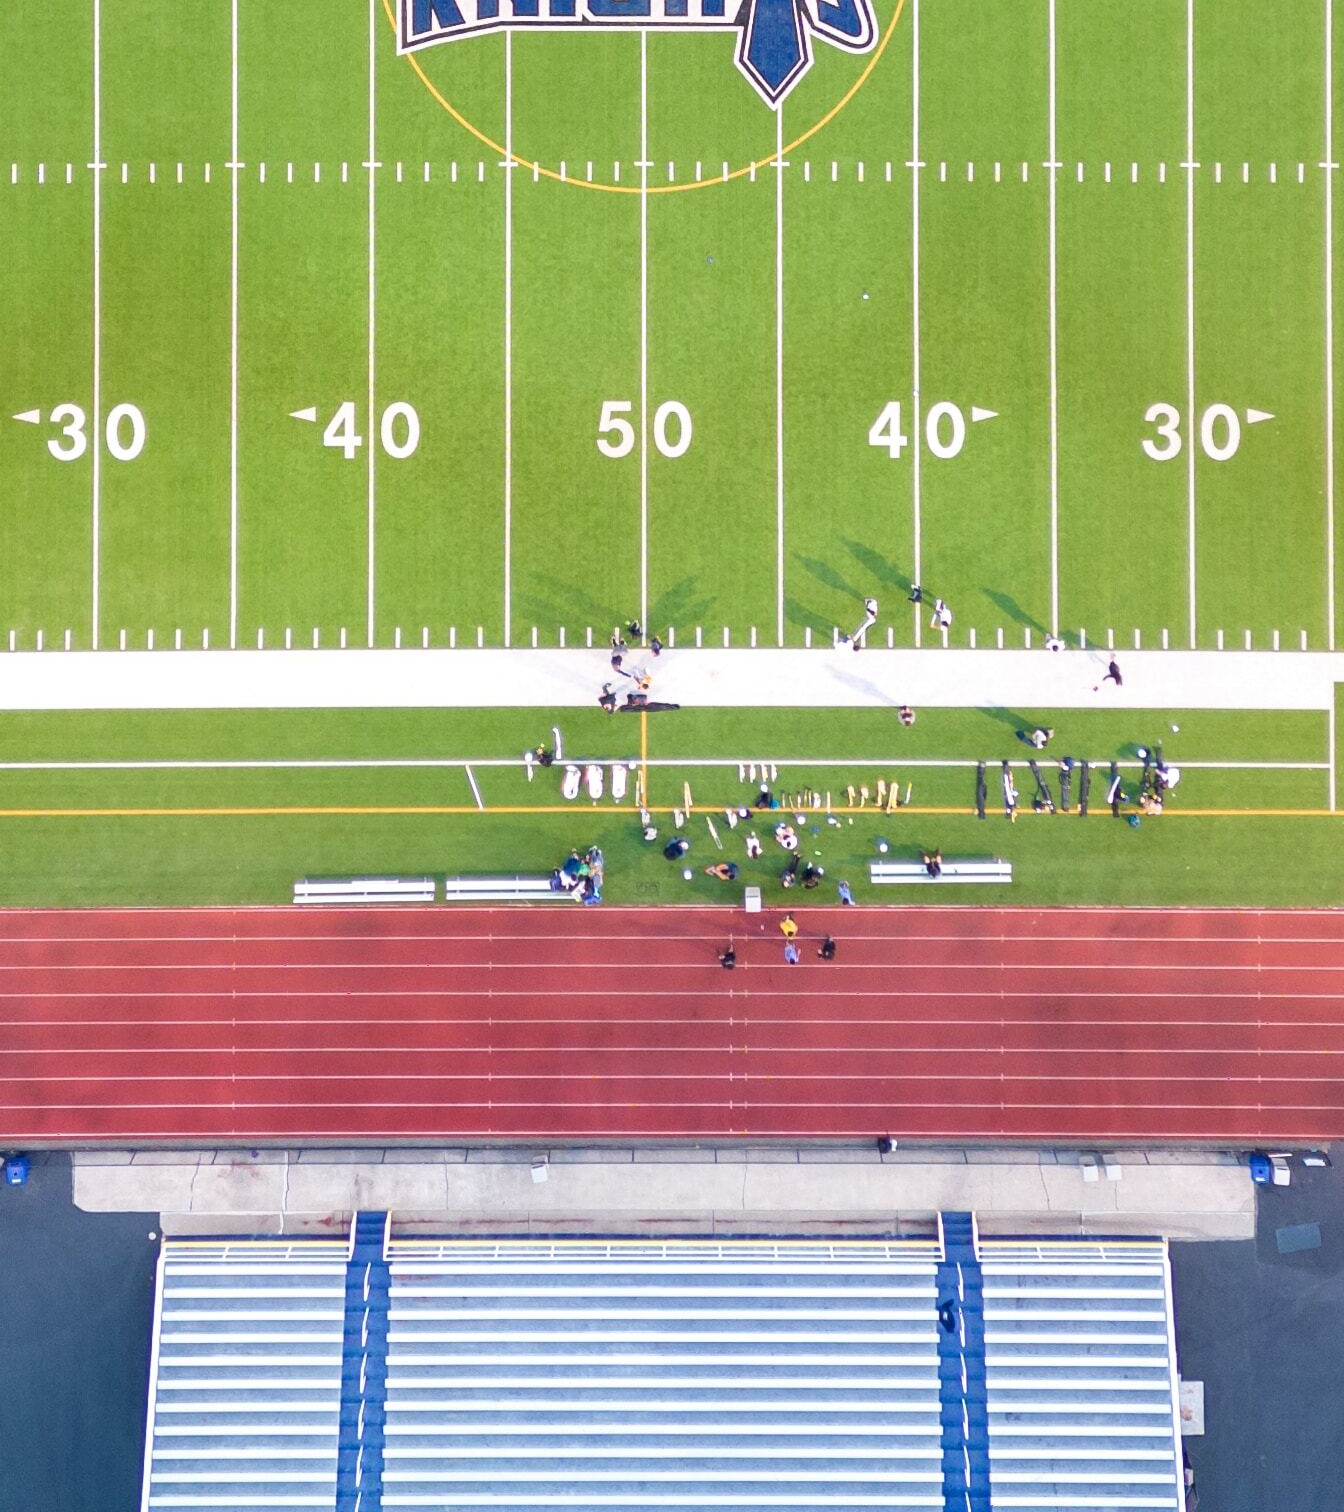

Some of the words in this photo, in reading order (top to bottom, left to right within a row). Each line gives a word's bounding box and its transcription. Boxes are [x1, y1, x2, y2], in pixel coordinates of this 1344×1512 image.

[47, 403, 146, 461] 30
[323, 401, 420, 459] 40
[596, 400, 693, 459] 50
[868, 401, 966, 459] 40
[1142, 403, 1241, 462] 30
